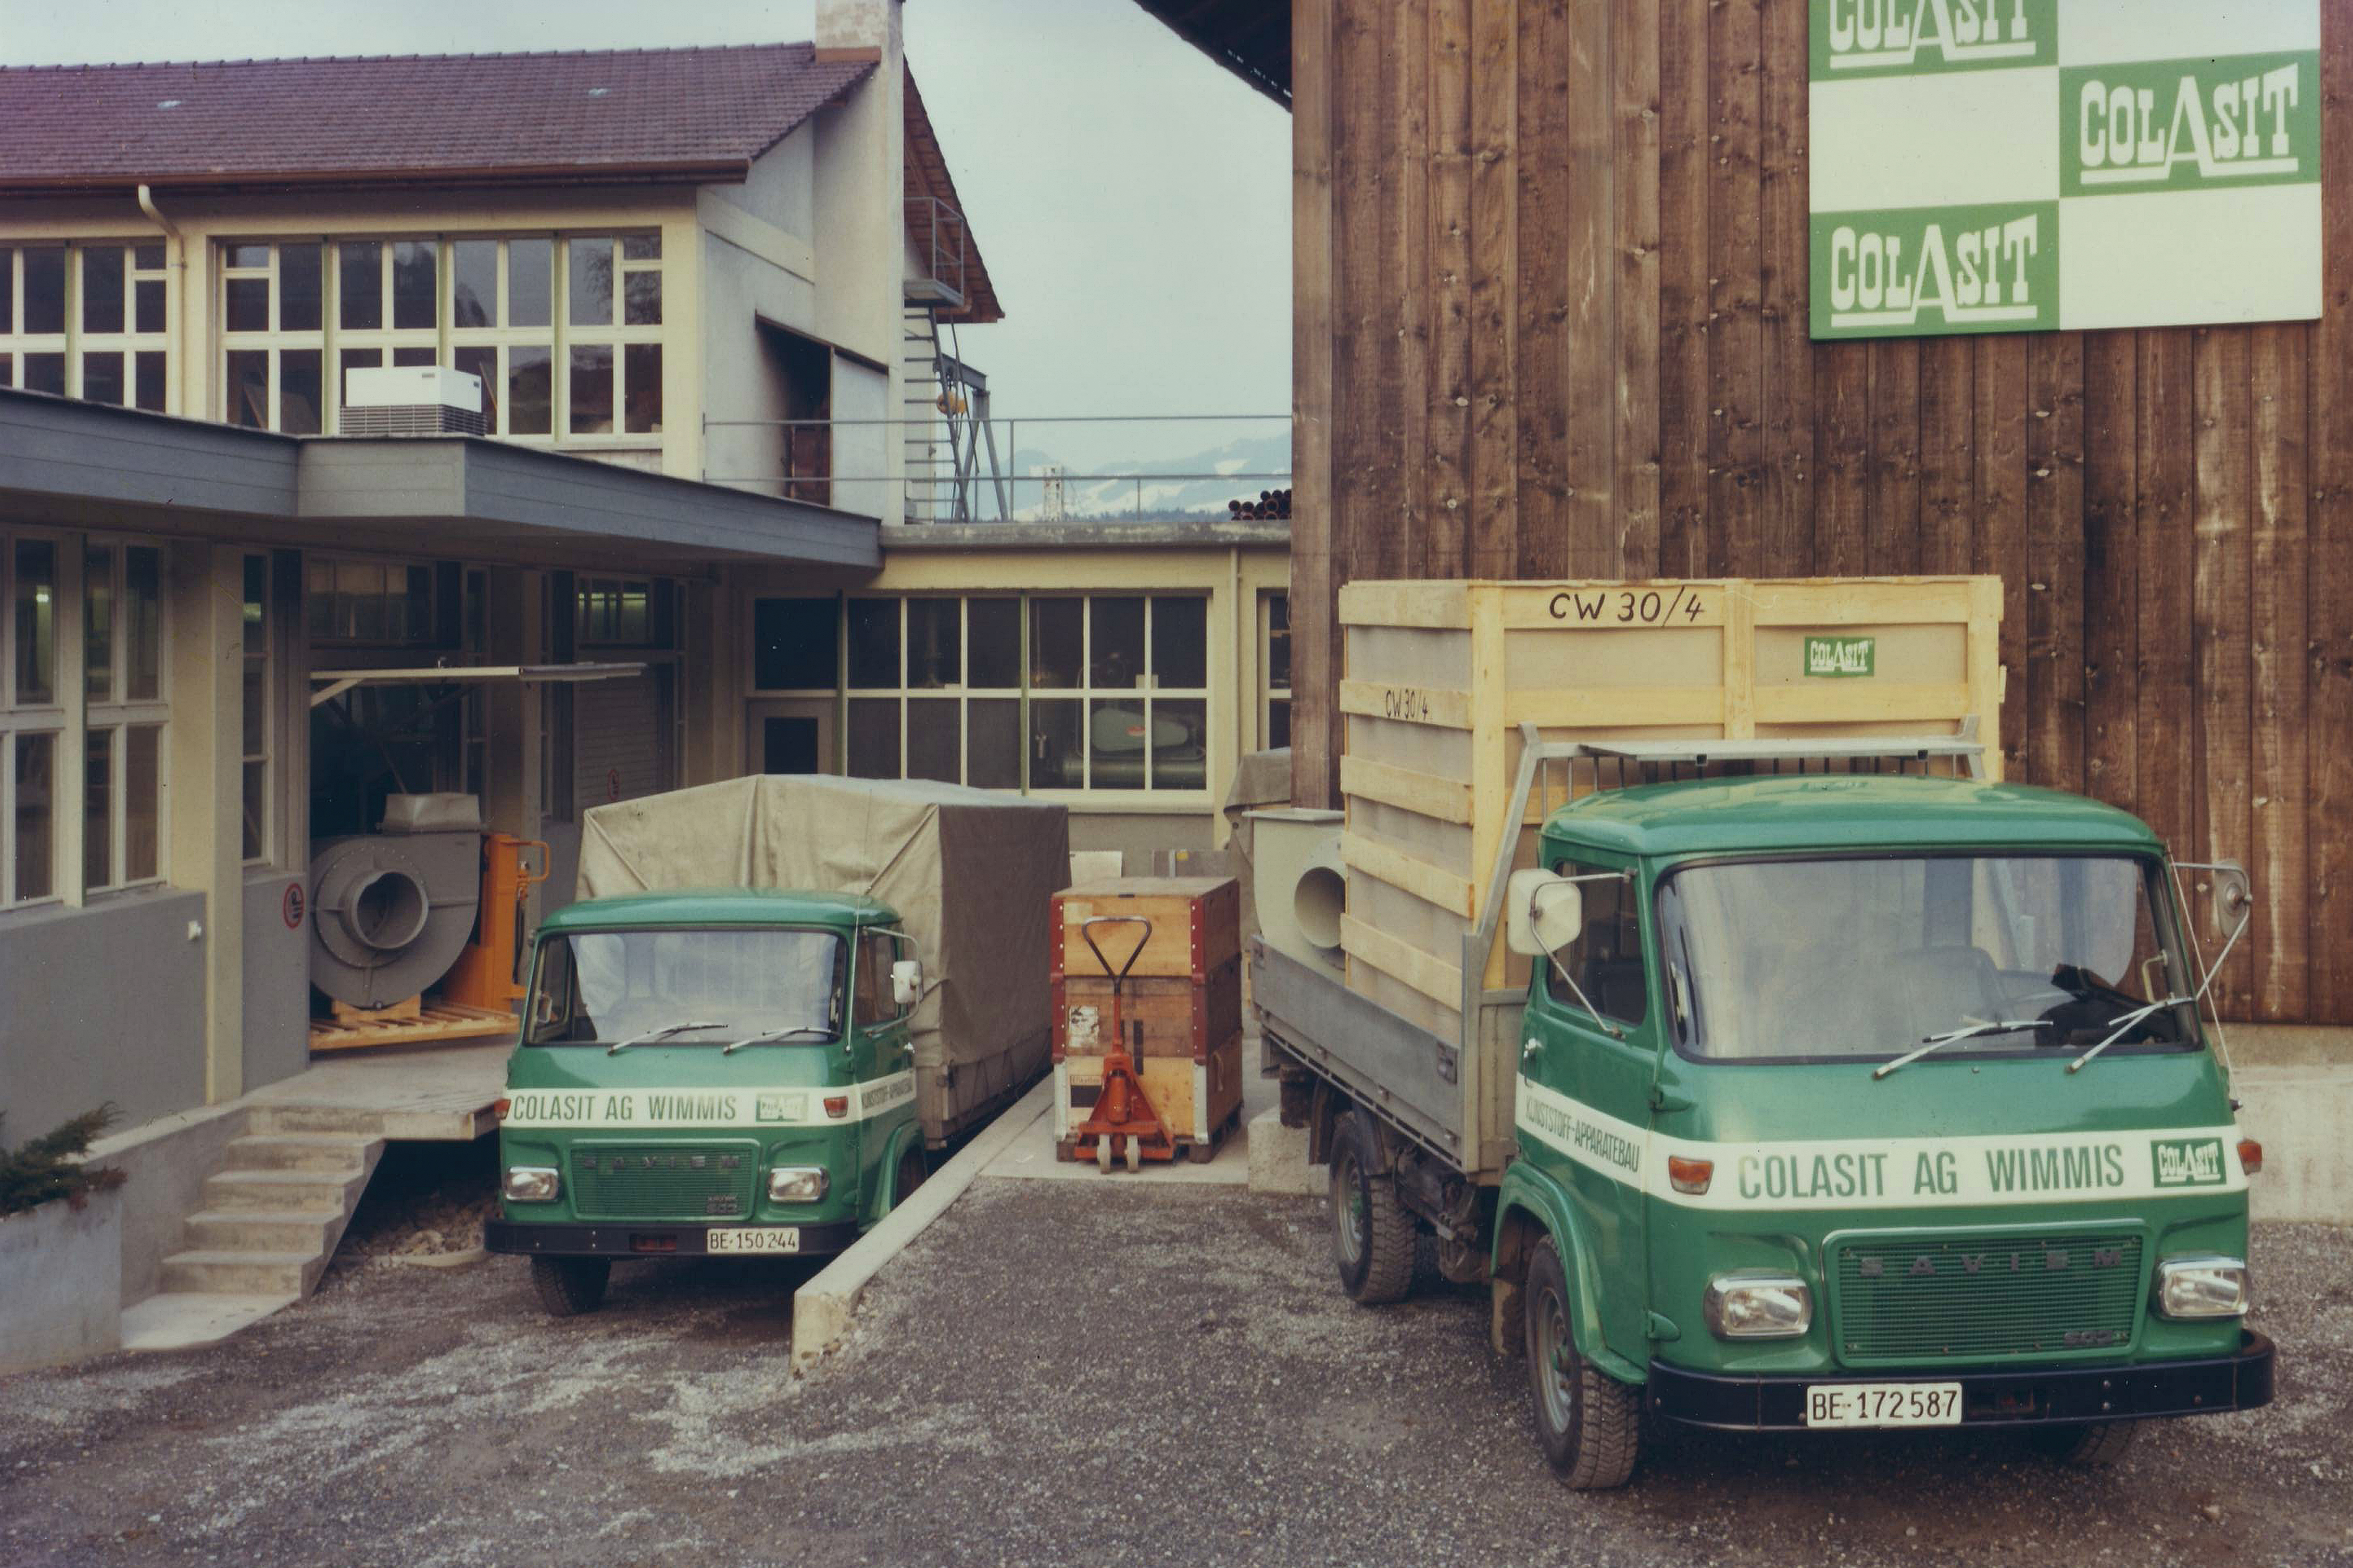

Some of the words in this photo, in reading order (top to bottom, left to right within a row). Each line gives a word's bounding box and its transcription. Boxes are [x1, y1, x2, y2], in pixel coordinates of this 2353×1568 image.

[2080, 63, 2299, 185] COLASIT
[1831, 214, 2038, 328] COLASIT
[1549, 592, 1605, 621] CW
[1617, 585, 1705, 627] 30/4
[1810, 640, 1868, 673] COLASIT
[1386, 689, 1402, 718] CW
[514, 1095, 596, 1120] COLASIT
[605, 1095, 632, 1120] AG
[648, 1095, 737, 1120] WIMMIS
[1738, 1153, 1888, 1199] COLASIT
[1913, 1150, 1958, 1195] AG
[1985, 1144, 2124, 1193] WIMMIS
[2157, 1141, 2222, 1183] COLASIT
[1859, 1249, 2123, 1277] SAVIEM
